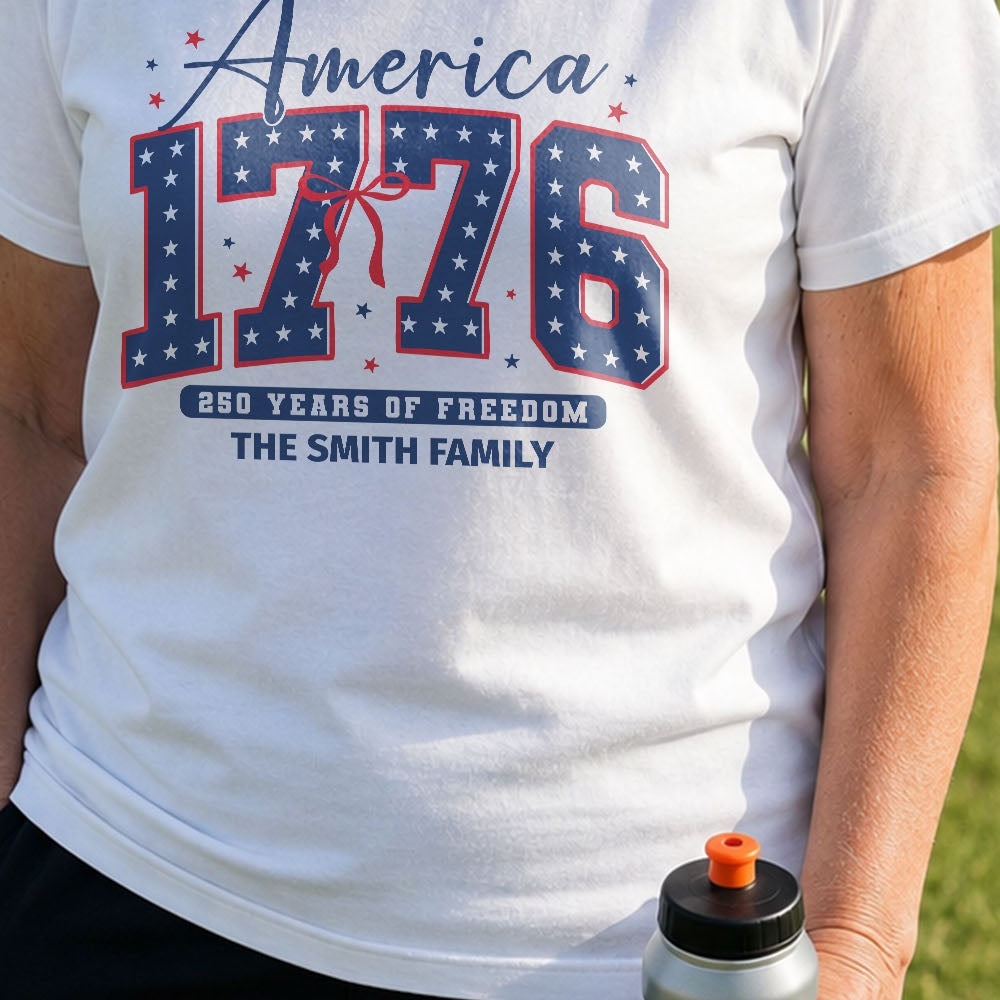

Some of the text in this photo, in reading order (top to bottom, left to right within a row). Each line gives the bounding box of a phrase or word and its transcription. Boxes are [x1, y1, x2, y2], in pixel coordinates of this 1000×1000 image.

[122, 105, 669, 389] 1776
[198, 391, 588, 424] 250 YEARS OF FREEDOM
[231, 432, 555, 469] THE SMITH FAMILY
